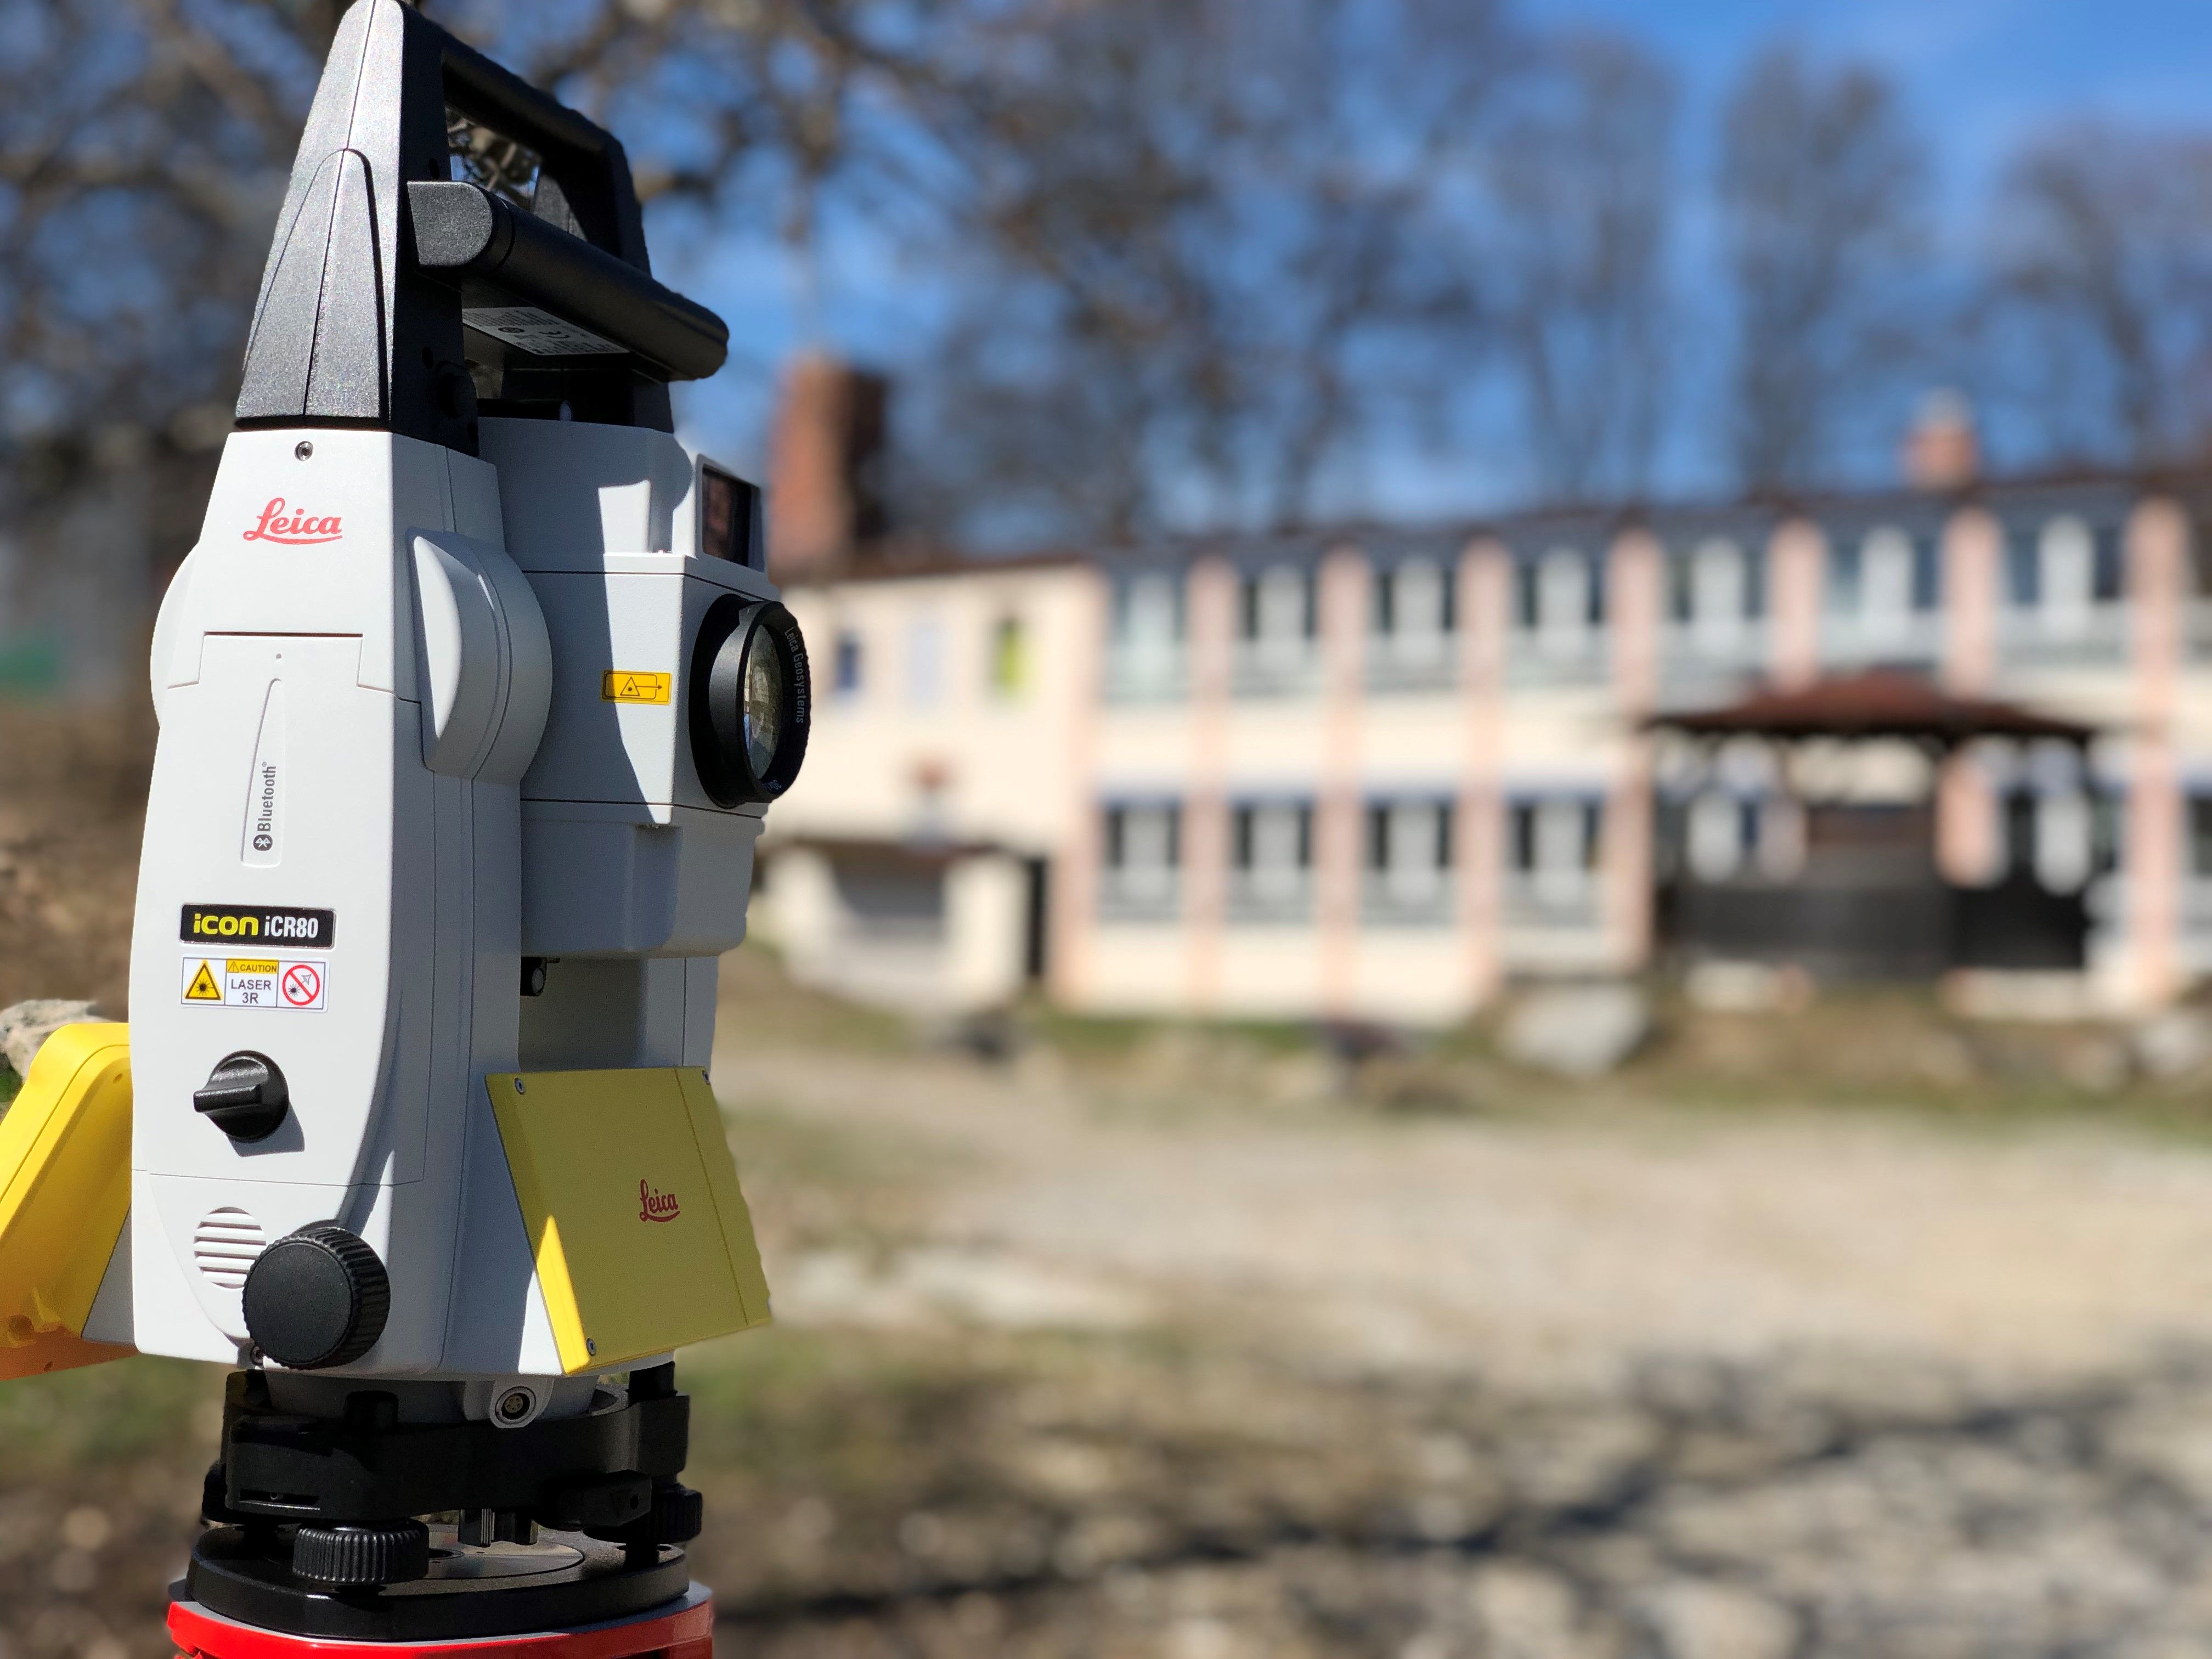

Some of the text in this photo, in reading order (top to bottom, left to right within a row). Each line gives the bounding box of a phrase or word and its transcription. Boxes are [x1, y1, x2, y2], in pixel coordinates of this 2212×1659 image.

[243, 497, 343, 545] Leica
[785, 627, 806, 724] Leica Geosystems
[264, 916, 319, 938] iCR80
[240, 963, 277, 973] CAUTION
[230, 979, 272, 990] LASER
[242, 992, 259, 1004] 3R
[639, 1178, 680, 1222] Leica
